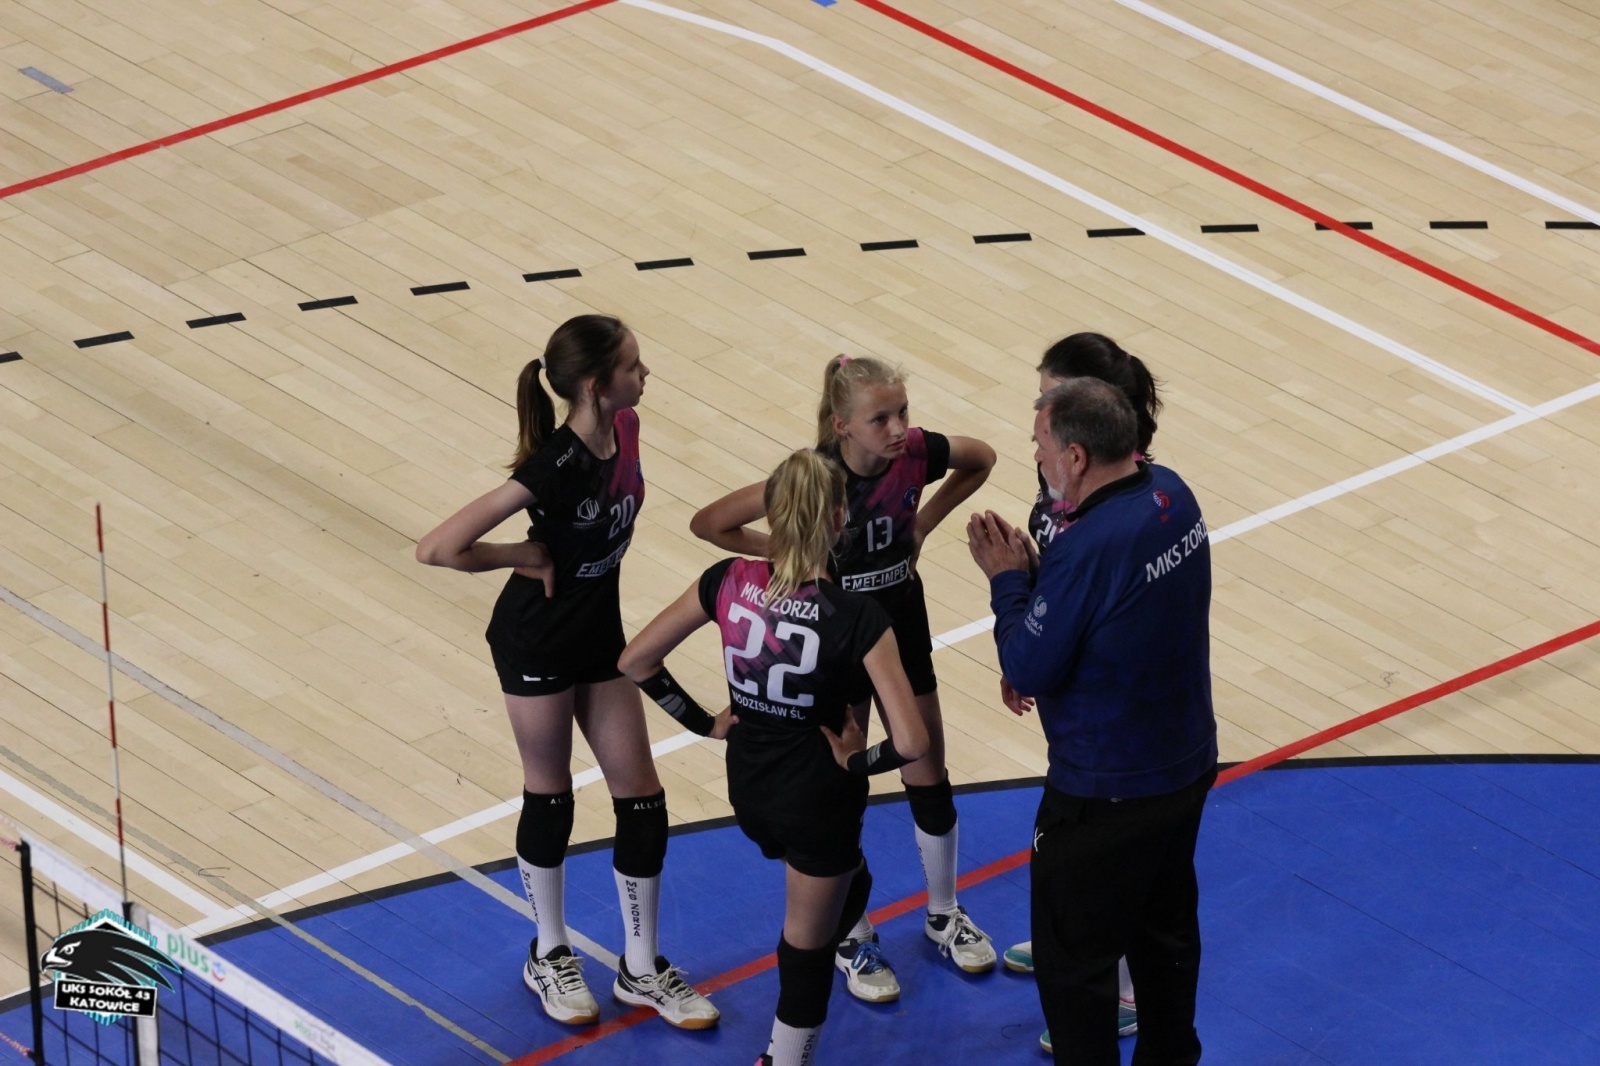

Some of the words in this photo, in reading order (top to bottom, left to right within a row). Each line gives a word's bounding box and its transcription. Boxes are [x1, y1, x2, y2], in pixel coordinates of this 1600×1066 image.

[608, 494, 635, 540] 20
[866, 516, 893, 553] 13
[1145, 543, 1182, 582] MKS
[1181, 516, 1209, 558] ZORZ
[740, 581, 769, 608] MKS
[769, 595, 820, 621] ZORZA
[725, 602, 820, 707] 22
[731, 688, 788, 718] WODZISŁAW
[166, 933, 210, 974] plus
[800, 1034, 816, 1066] ZORZ
